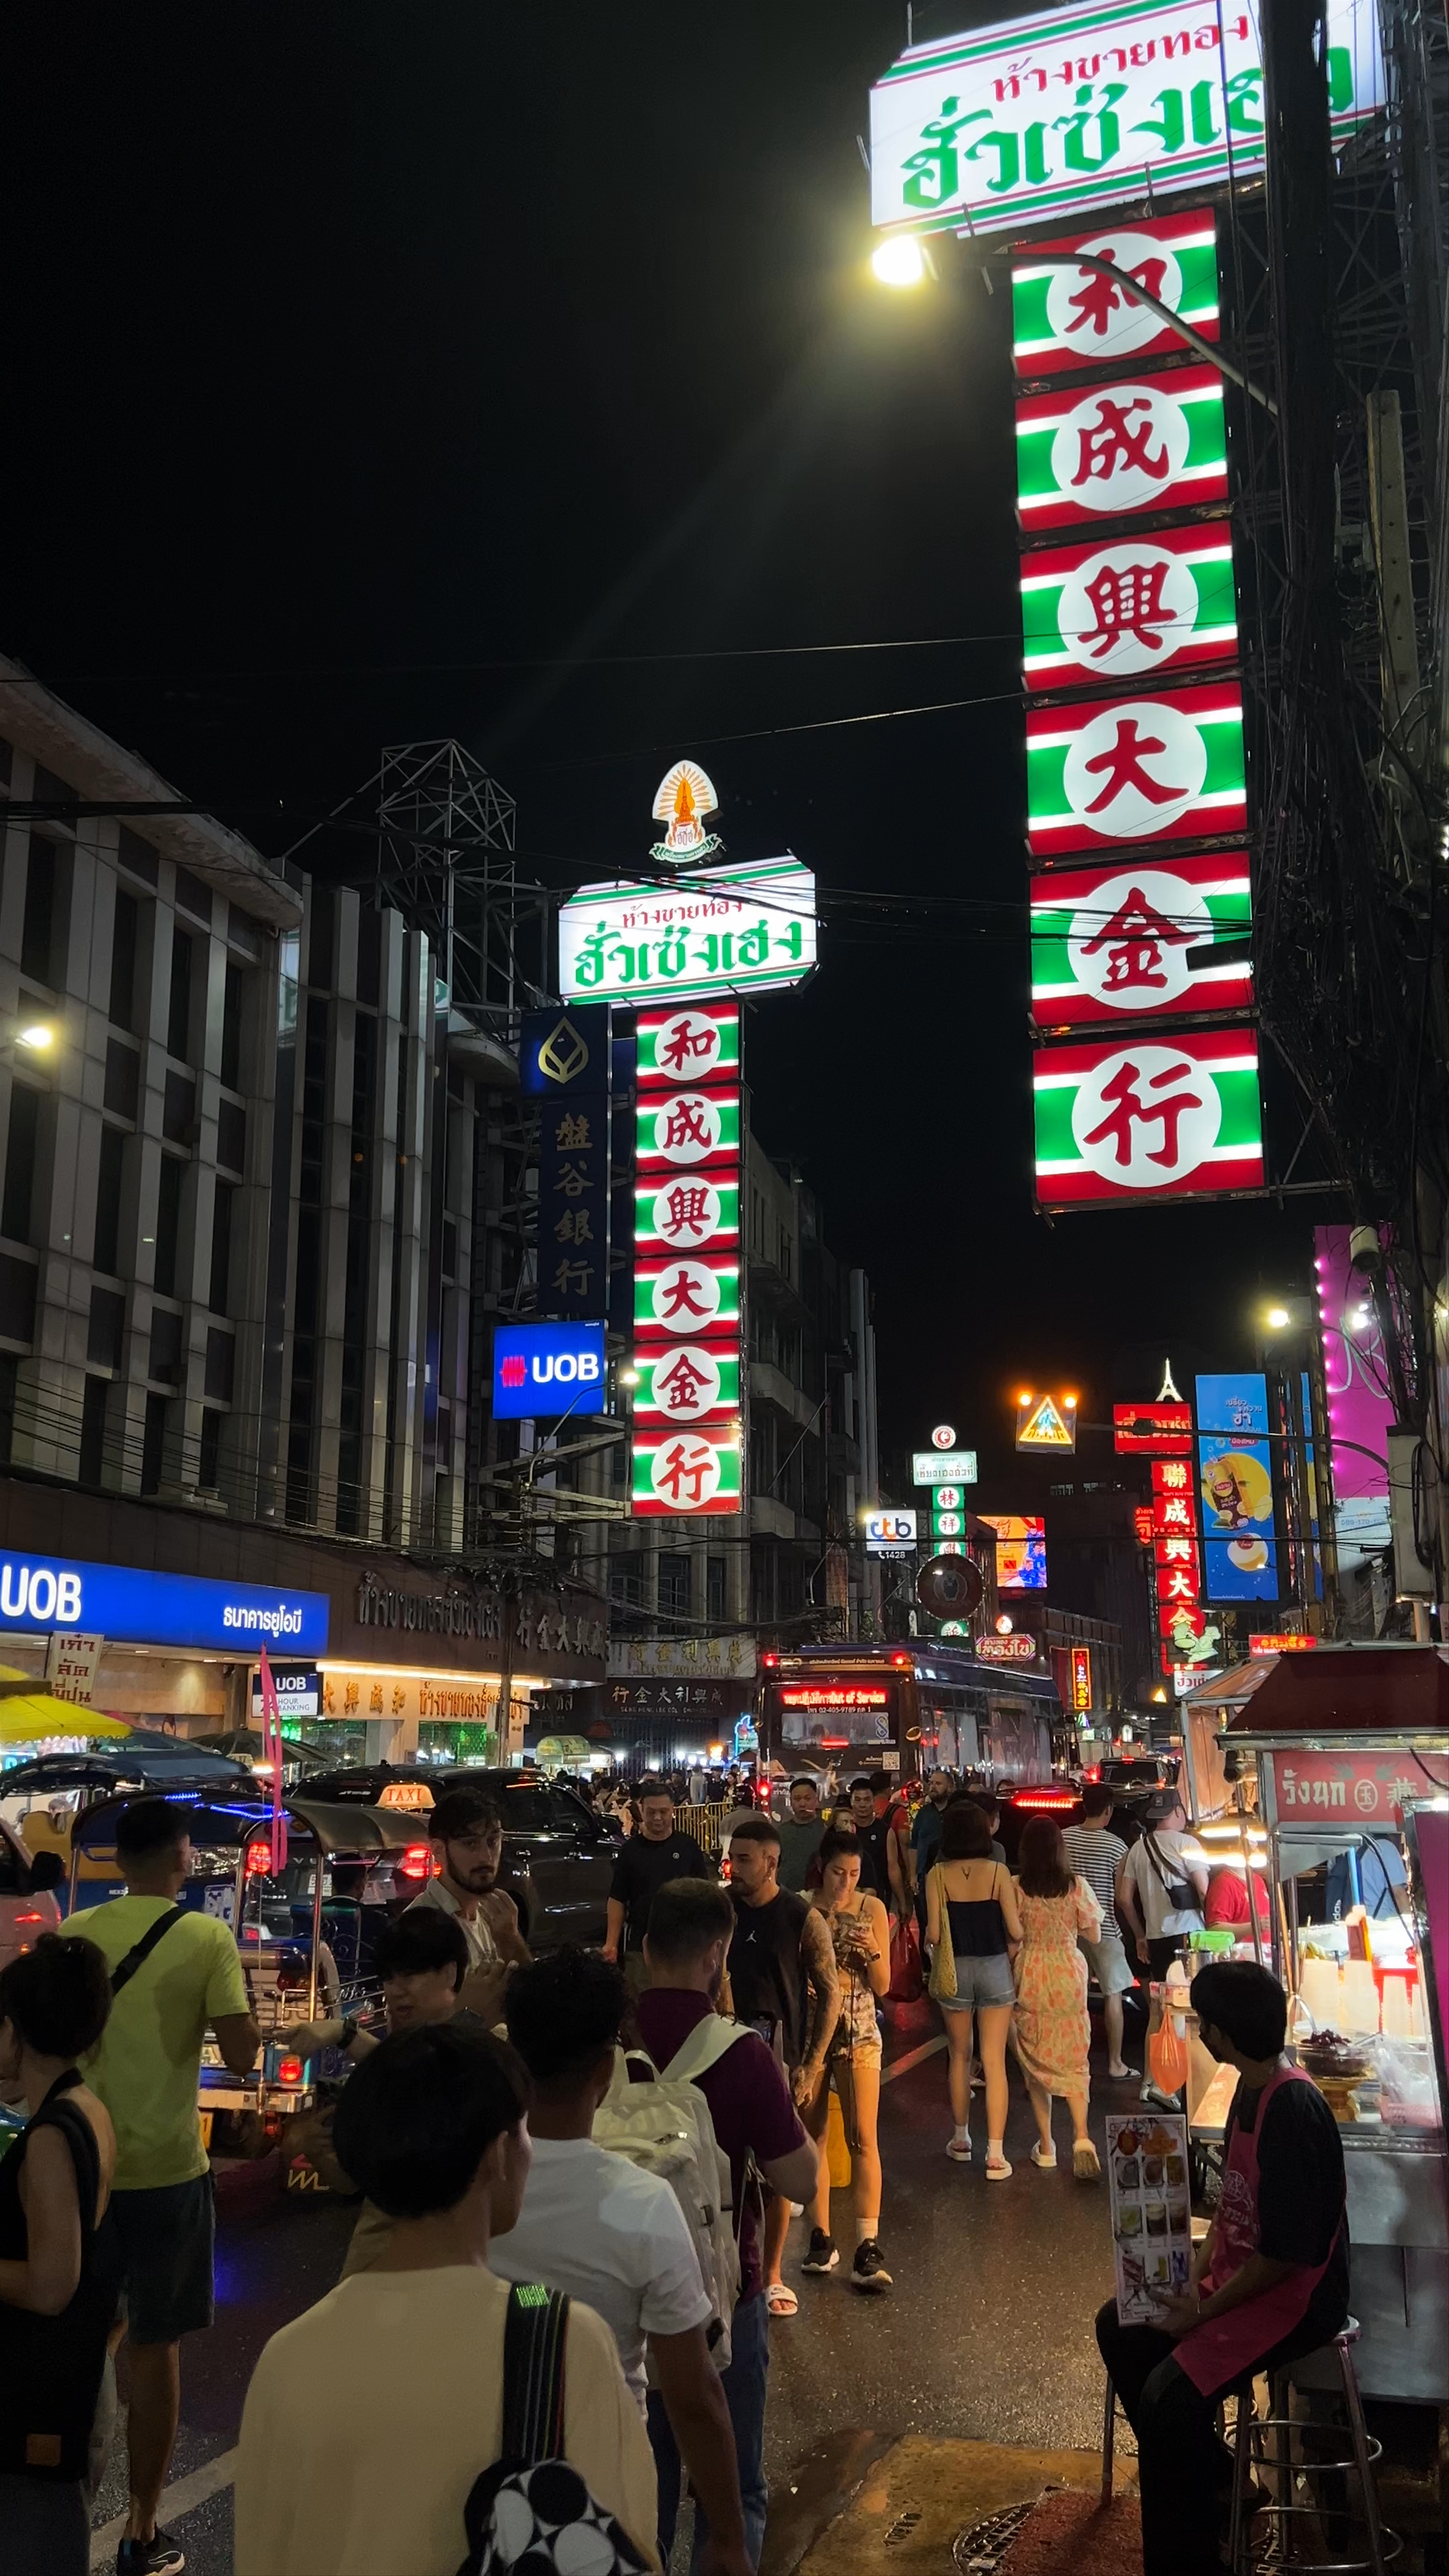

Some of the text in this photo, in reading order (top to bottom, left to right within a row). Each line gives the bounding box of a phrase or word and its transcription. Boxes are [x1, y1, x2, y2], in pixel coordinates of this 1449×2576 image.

[991, 15, 1249, 102] ห้างขายทอง
[622, 901, 743, 929] ห้างขายทอง
[574, 920, 803, 987] ฮั่วเซ่งเฮง
[657, 1019, 717, 1502] 和成興大金行
[532, 1353, 599, 1383] UOB
[871, 1518, 912, 1540] ttb
[1, 1565, 82, 1622] UOB
[223, 1606, 302, 1637] ธนาคารยูโอบี
[276, 1676, 306, 1691] UOB
[387, 1788, 422, 1801] TAXI
[1282, 1769, 1346, 1809] รังนก
